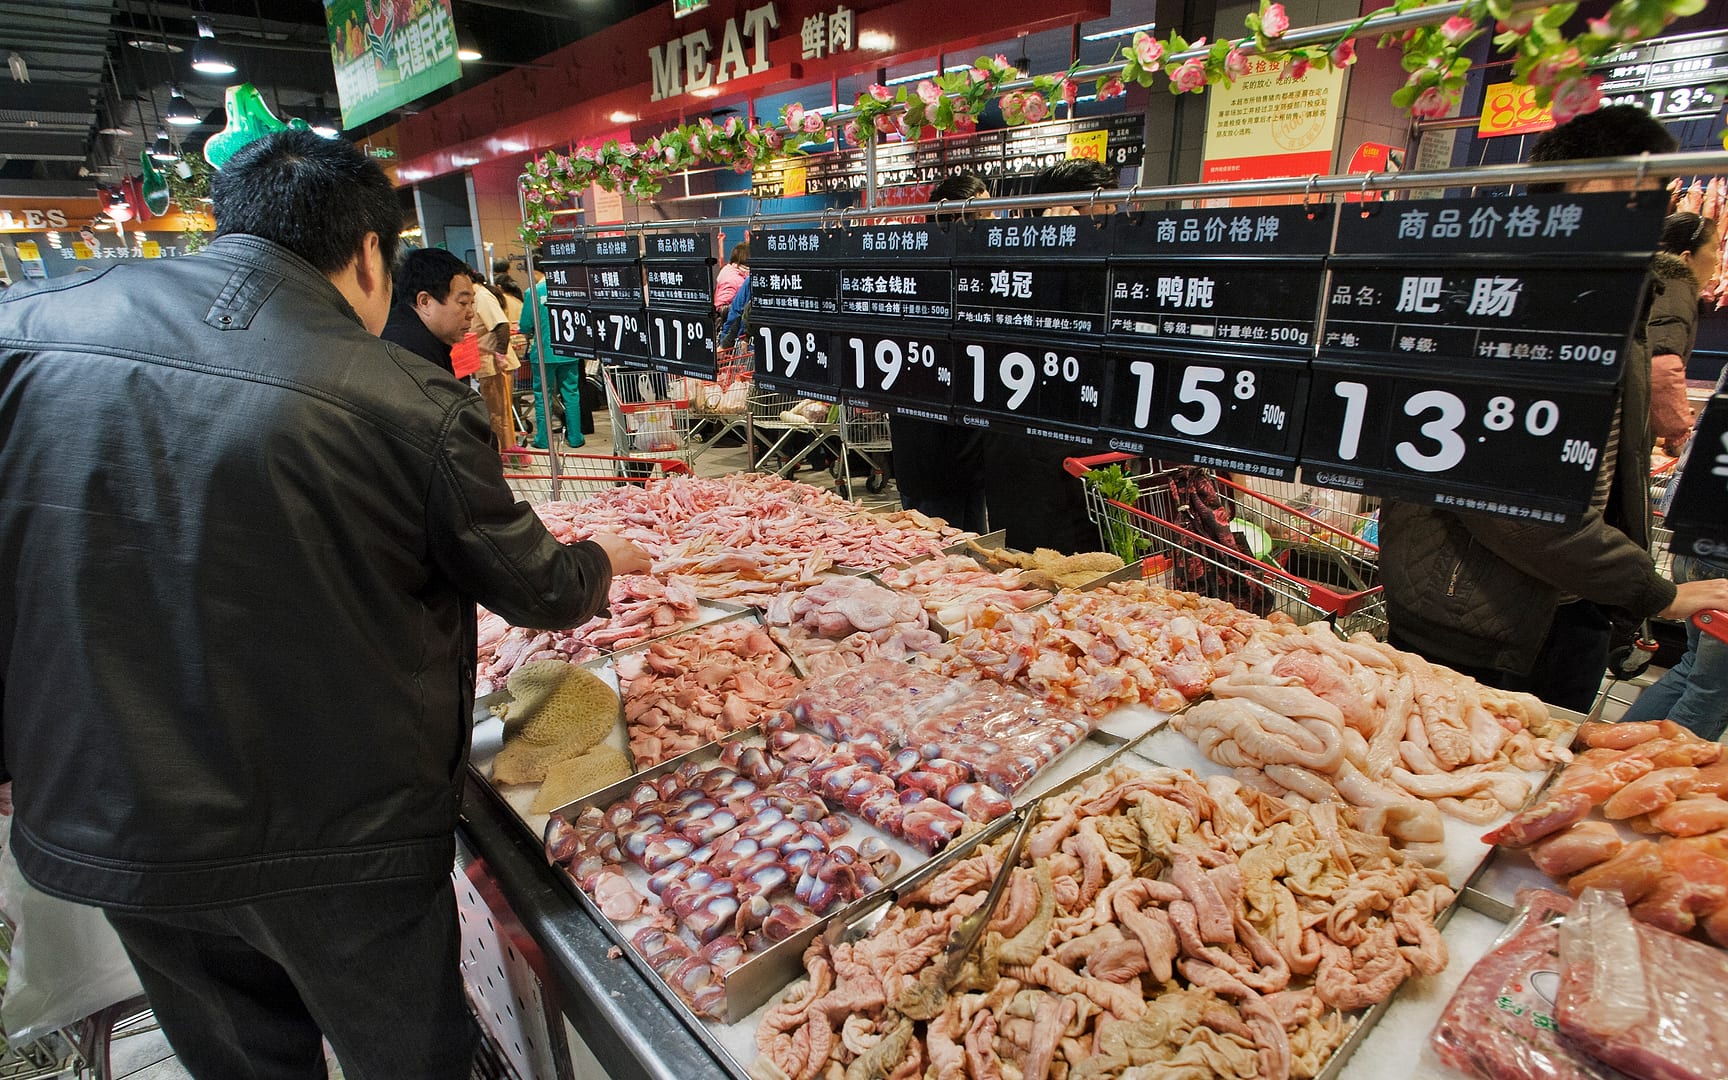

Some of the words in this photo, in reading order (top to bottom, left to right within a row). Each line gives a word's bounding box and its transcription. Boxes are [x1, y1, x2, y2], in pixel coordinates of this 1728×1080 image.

[800, 5, 855, 61] 鲜肉
[649, 2, 780, 102] MEAT
[988, 224, 1077, 248] 商品价格牌
[1157, 215, 1280, 243] 商品价格牌
[1398, 204, 1583, 239] 商品价格牌
[657, 238, 696, 253] 商品价格牌
[767, 234, 820, 251] 商品价格牌
[862, 231, 929, 251] 商品价格牌
[660, 271, 683, 287] 鸭翅中
[769, 274, 802, 291] 猪小肚
[842, 278, 862, 291] 品名:
[861, 276, 917, 295] 冻金钱肚
[958, 278, 984, 293] 品名:
[989, 270, 1033, 298] 鸡冠
[1114, 282, 1150, 300] 品名:
[1156, 276, 1215, 308] 鸭肫
[931, 305, 950, 317] 500g
[1332, 286, 1382, 306] 品名:
[1395, 275, 1521, 317] 肥肠
[551, 309, 586, 342] 13.80
[654, 318, 704, 360] 11.80
[1218, 324, 1268, 340] 计量单位:
[1270, 327, 1309, 345] 500g
[760, 327, 816, 378] 19.8
[849, 338, 935, 391] 19.50
[1325, 332, 1360, 348] 产地:
[1399, 336, 1438, 353] 等级:
[1478, 341, 1553, 360] 计量单位:
[1559, 345, 1617, 366] 500g
[966, 344, 1079, 410] 19.80
[1081, 385, 1098, 407] 500g
[1130, 361, 1256, 436] 15.8
[1262, 404, 1286, 430] 500g
[1334, 381, 1559, 472] 13.80
[1561, 439, 1597, 471] 500g
[1193, 454, 1284, 478] 重庆市物价局检查分局监制
[1434, 493, 1566, 523] 重庆市物价局检查分局监制
